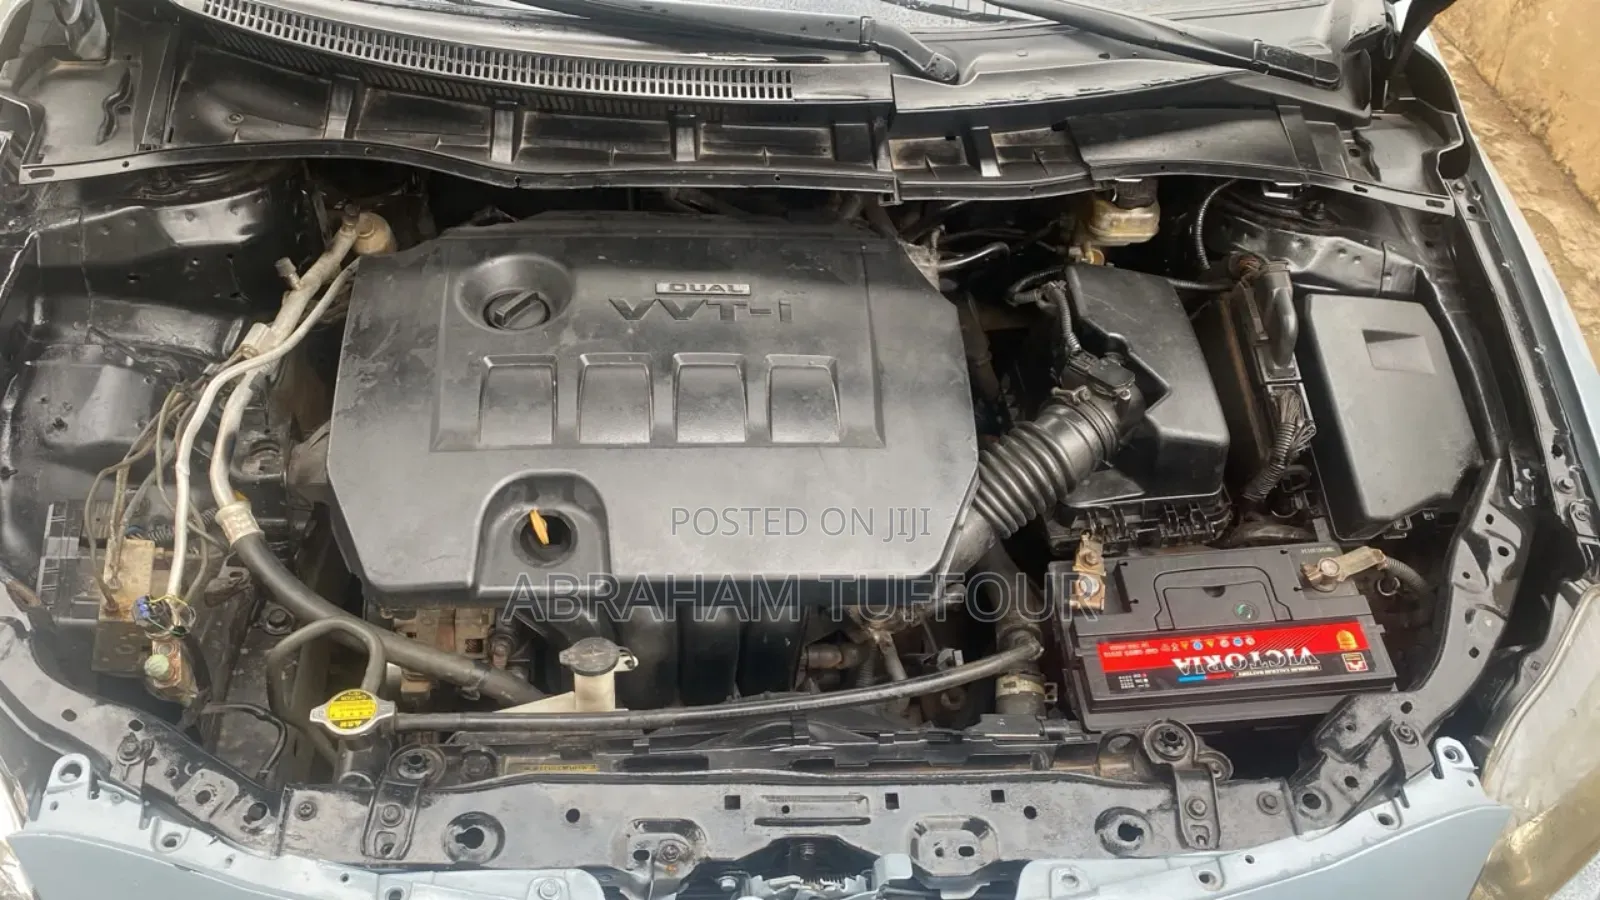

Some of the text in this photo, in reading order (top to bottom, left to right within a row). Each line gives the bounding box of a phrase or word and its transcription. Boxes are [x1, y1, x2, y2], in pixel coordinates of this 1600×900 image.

[669, 283, 744, 293] DUAL
[608, 299, 792, 322] VVT-i
[1171, 646, 1321, 676] VICTORIA
